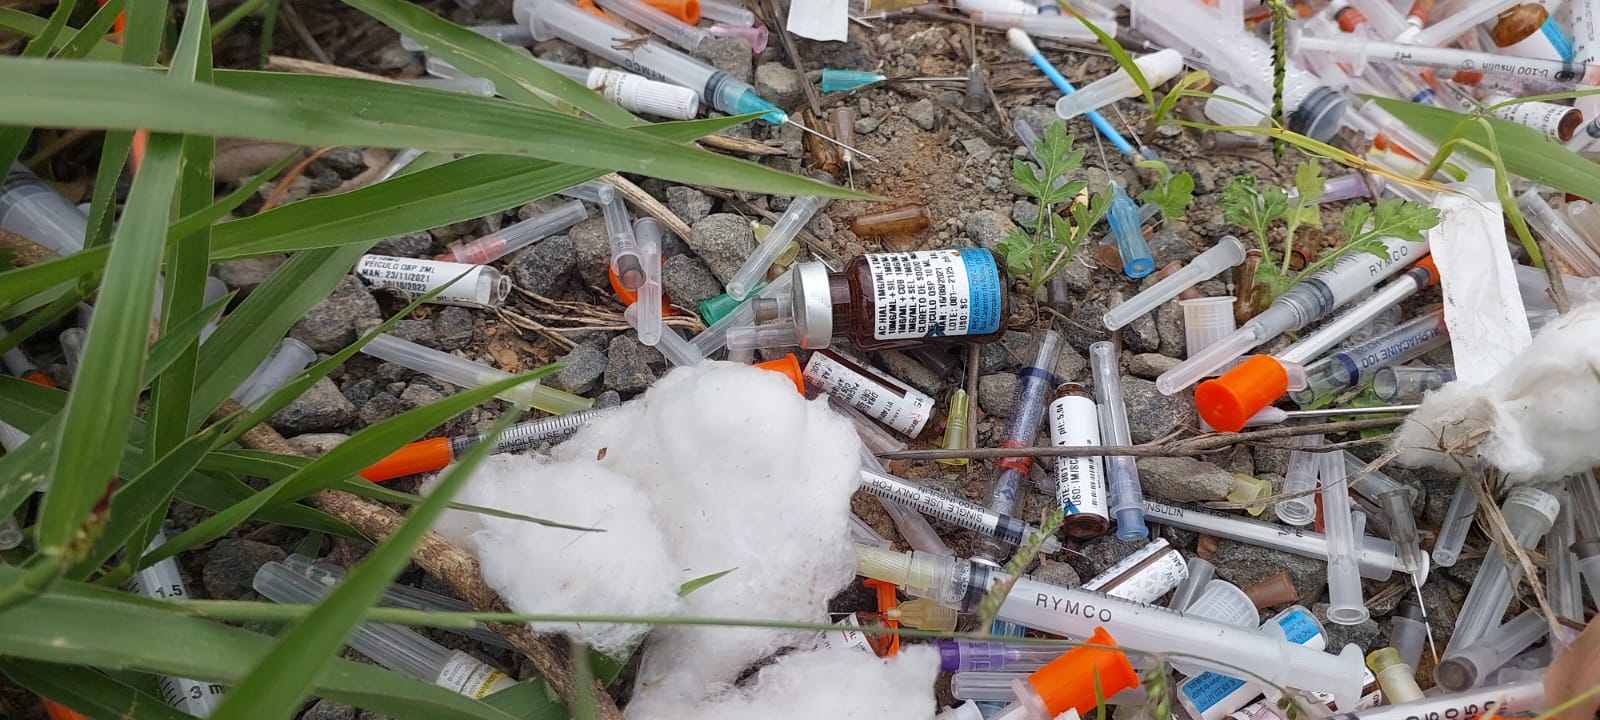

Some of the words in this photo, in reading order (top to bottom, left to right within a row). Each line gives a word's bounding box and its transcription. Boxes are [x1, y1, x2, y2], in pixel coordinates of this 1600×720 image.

[625, 59, 666, 83] RYMCO
[1482, 61, 1515, 73] Insulin
[1517, 66, 1549, 78] U-100
[365, 261, 399, 270] VEICULO
[420, 266, 436, 274] 2ML
[1368, 246, 1408, 277] RYMCO
[362, 269, 383, 278] MAN:
[386, 271, 430, 282] 23/11/2021
[917, 284, 926, 295] DE
[926, 281, 936, 297] QSP
[960, 298, 968, 309] SC
[917, 297, 927, 333] CLORETO
[948, 310, 958, 331] LOTE:
[958, 312, 968, 331] USO:
[878, 325, 887, 336] AC
[1381, 327, 1440, 361] ALPHACAINE
[1362, 353, 1380, 368] 100
[498, 436, 534, 450] SINGLE
[539, 430, 561, 441] USE
[563, 425, 579, 437] ON
[872, 478, 893, 492] FOR
[895, 486, 921, 501] ONLY
[918, 486, 957, 504] INSULIN
[923, 495, 944, 510] USE
[958, 501, 985, 514] U-100
[1147, 502, 1184, 517] NSULIN
[947, 506, 983, 523] SINGLE
[155, 584, 183, 598] 1.5
[1035, 593, 1112, 623] RYMCO
[189, 685, 203, 699] 3
